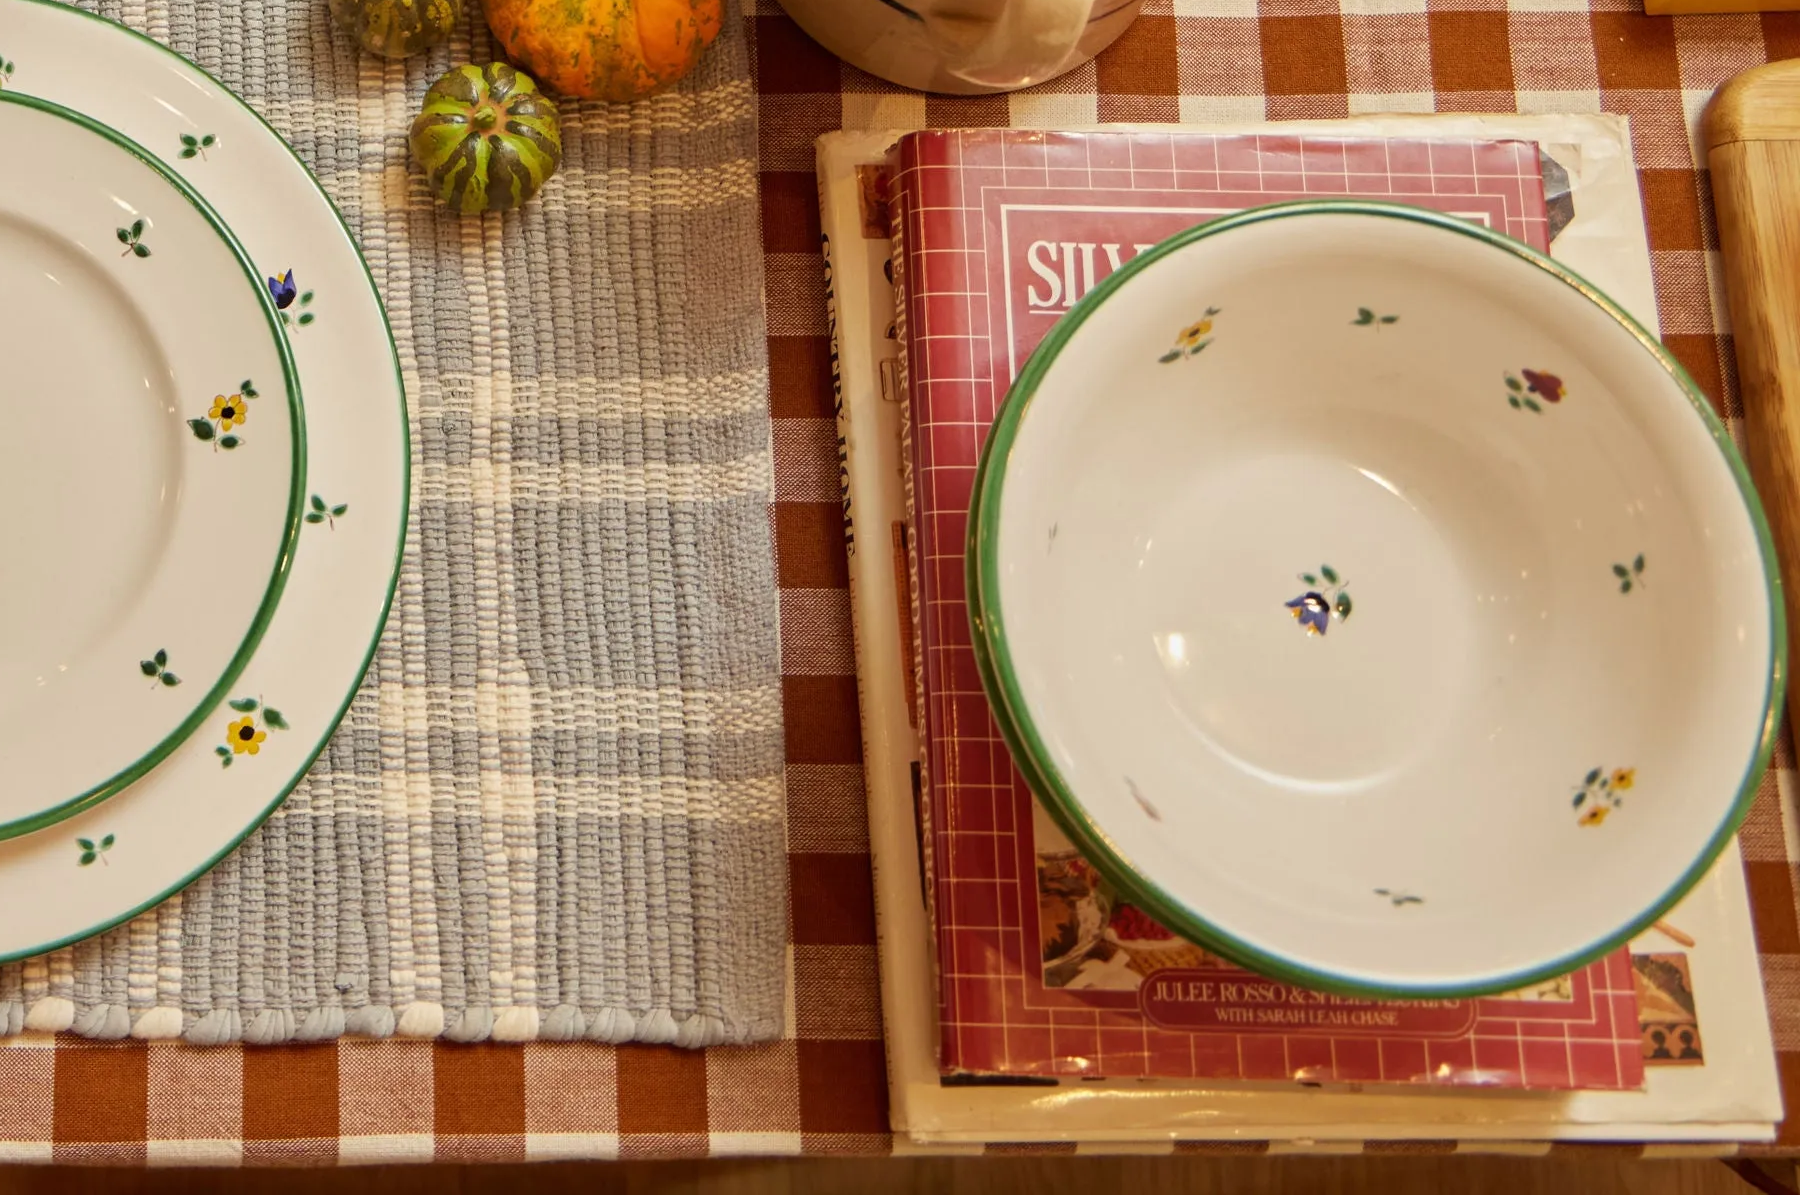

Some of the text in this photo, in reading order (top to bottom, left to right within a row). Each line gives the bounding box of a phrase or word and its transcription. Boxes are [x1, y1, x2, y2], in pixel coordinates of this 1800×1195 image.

[891, 207, 905, 274] THE
[1028, 239, 1156, 307] SILV
[894, 283, 910, 392] SILVER
[838, 438, 856, 558] HOME
[900, 400, 917, 520] PALATE
[907, 527, 920, 626] GOOD
[914, 636, 926, 738] TIMES
[1152, 981, 1216, 1004] JULEE
[1219, 982, 1287, 1004] ROSSO
[1288, 985, 1307, 1004] &
[1214, 1007, 1399, 1026] WITH SARAH LEAH CHASE
